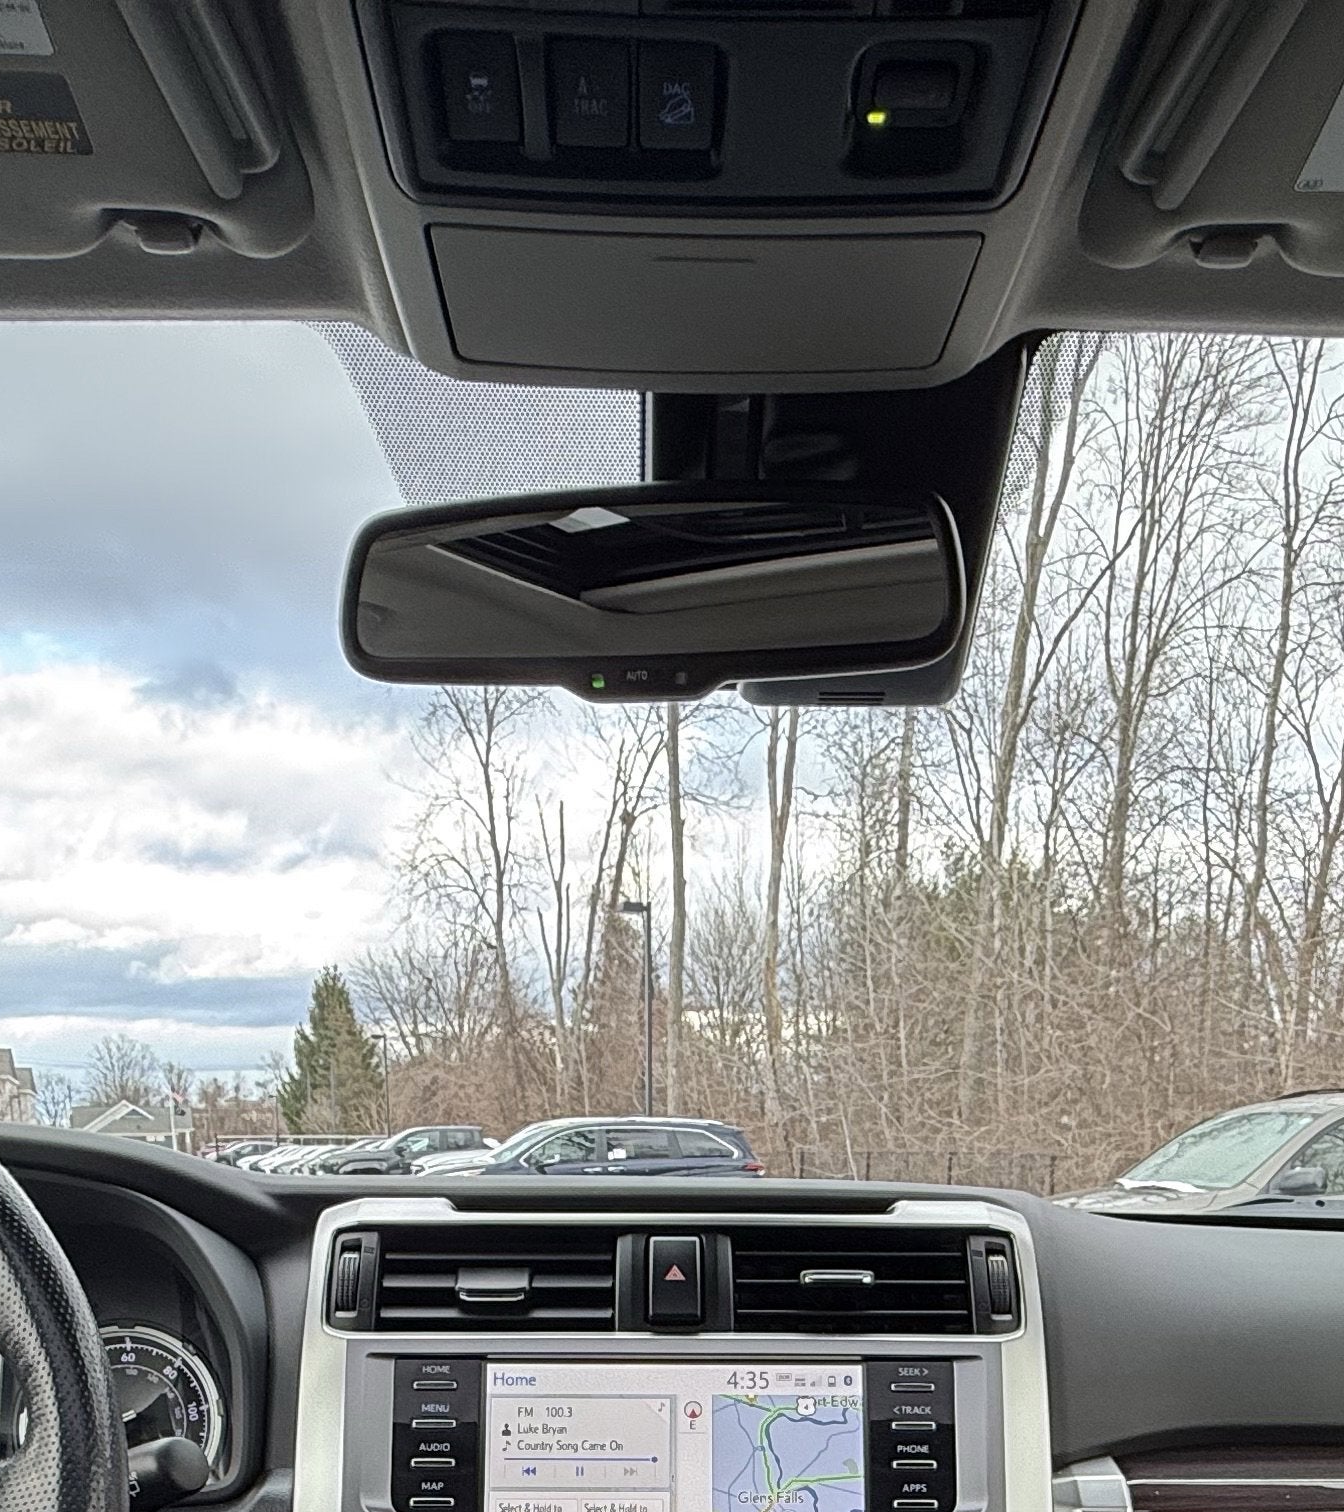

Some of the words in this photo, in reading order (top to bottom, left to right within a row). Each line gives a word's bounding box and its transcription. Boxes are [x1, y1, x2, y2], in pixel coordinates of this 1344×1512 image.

[663, 82, 690, 95] DAC
[626, 671, 648, 681] AUTO
[120, 1352, 136, 1363] 60
[163, 1365, 178, 1380] 80
[422, 1365, 451, 1375] HOME
[898, 1367, 921, 1377] SEEK
[492, 1371, 537, 1387] Home
[726, 1370, 770, 1390] 4:35
[186, 1400, 200, 1422] 100
[421, 1403, 450, 1414] MENU
[517, 1406, 534, 1418] FM
[545, 1406, 573, 1418] 100.3
[901, 1405, 933, 1416] TRACK
[689, 1419, 697, 1430] E
[517, 1423, 539, 1435] Luke
[542, 1423, 568, 1438] Bryan
[419, 1442, 451, 1452] AUDIO
[516, 1440, 553, 1455] Country
[556, 1440, 579, 1455] Song
[581, 1440, 607, 1451] Came
[609, 1440, 624, 1451] On
[897, 1444, 929, 1454] PHONE
[421, 1481, 445, 1491] MAP
[902, 1483, 928, 1493] APPS
[737, 1491, 773, 1504] Glens
[777, 1491, 805, 1504] Falls
